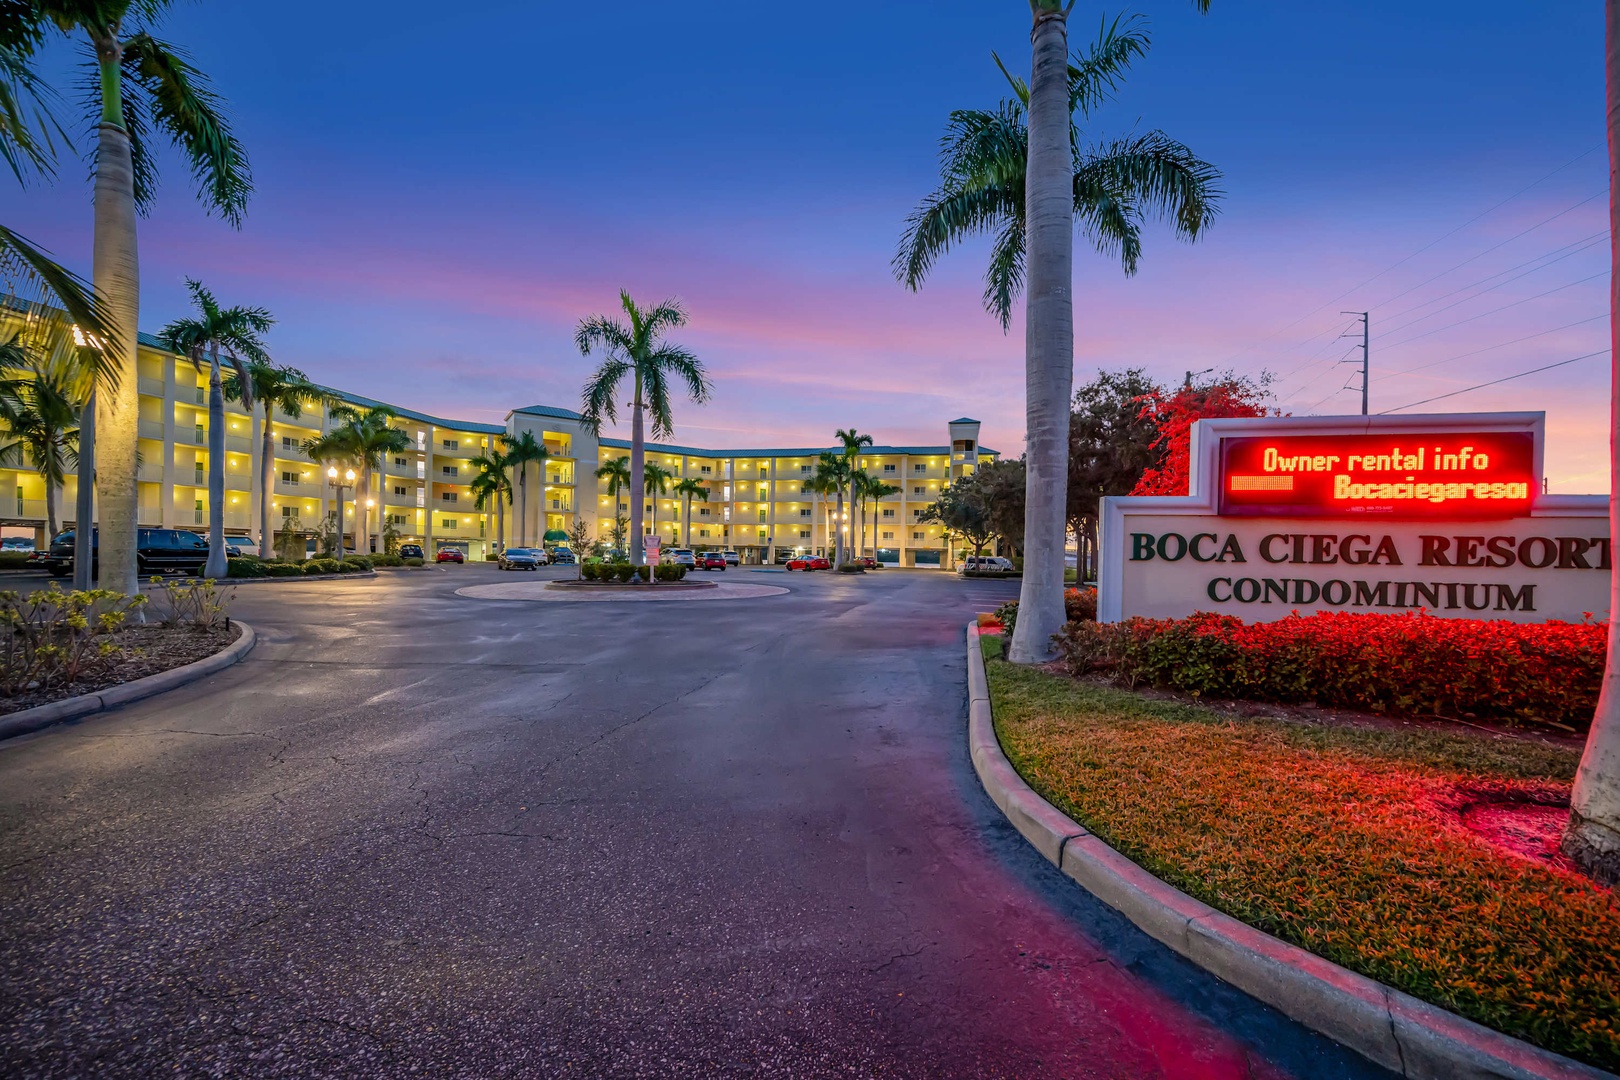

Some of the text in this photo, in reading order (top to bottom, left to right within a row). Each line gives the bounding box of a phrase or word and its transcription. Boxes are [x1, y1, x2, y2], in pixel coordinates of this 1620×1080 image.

[1264, 447, 1488, 471] Owner rental info
[1129, 533, 1612, 570] BOCA CIEGA RESORT
[1207, 577, 1537, 611] CONDOMINIUM
